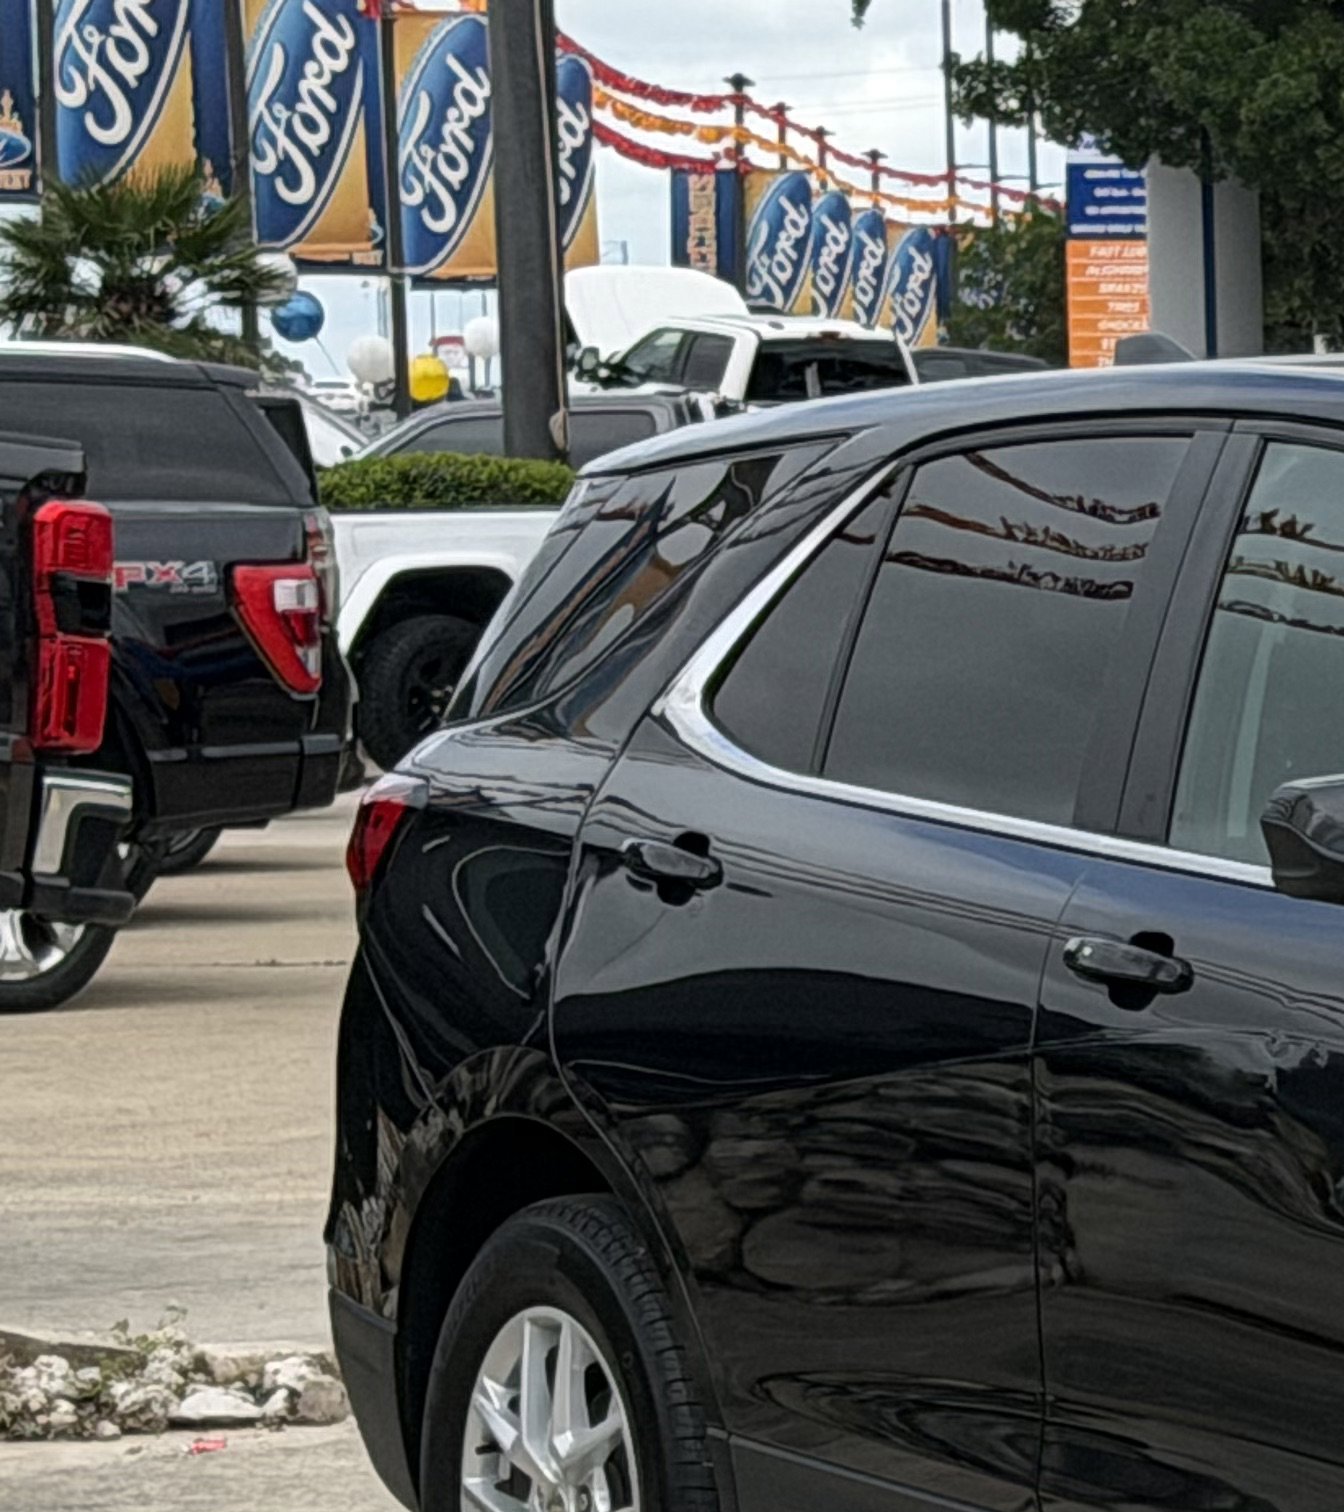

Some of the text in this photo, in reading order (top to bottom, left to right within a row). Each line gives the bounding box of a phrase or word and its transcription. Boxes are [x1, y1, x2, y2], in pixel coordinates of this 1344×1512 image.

[252, 0, 355, 205] Ford
[400, 52, 491, 233] Ford
[746, 195, 810, 308] Ford
[812, 214, 849, 319] ord
[853, 230, 886, 325] ord
